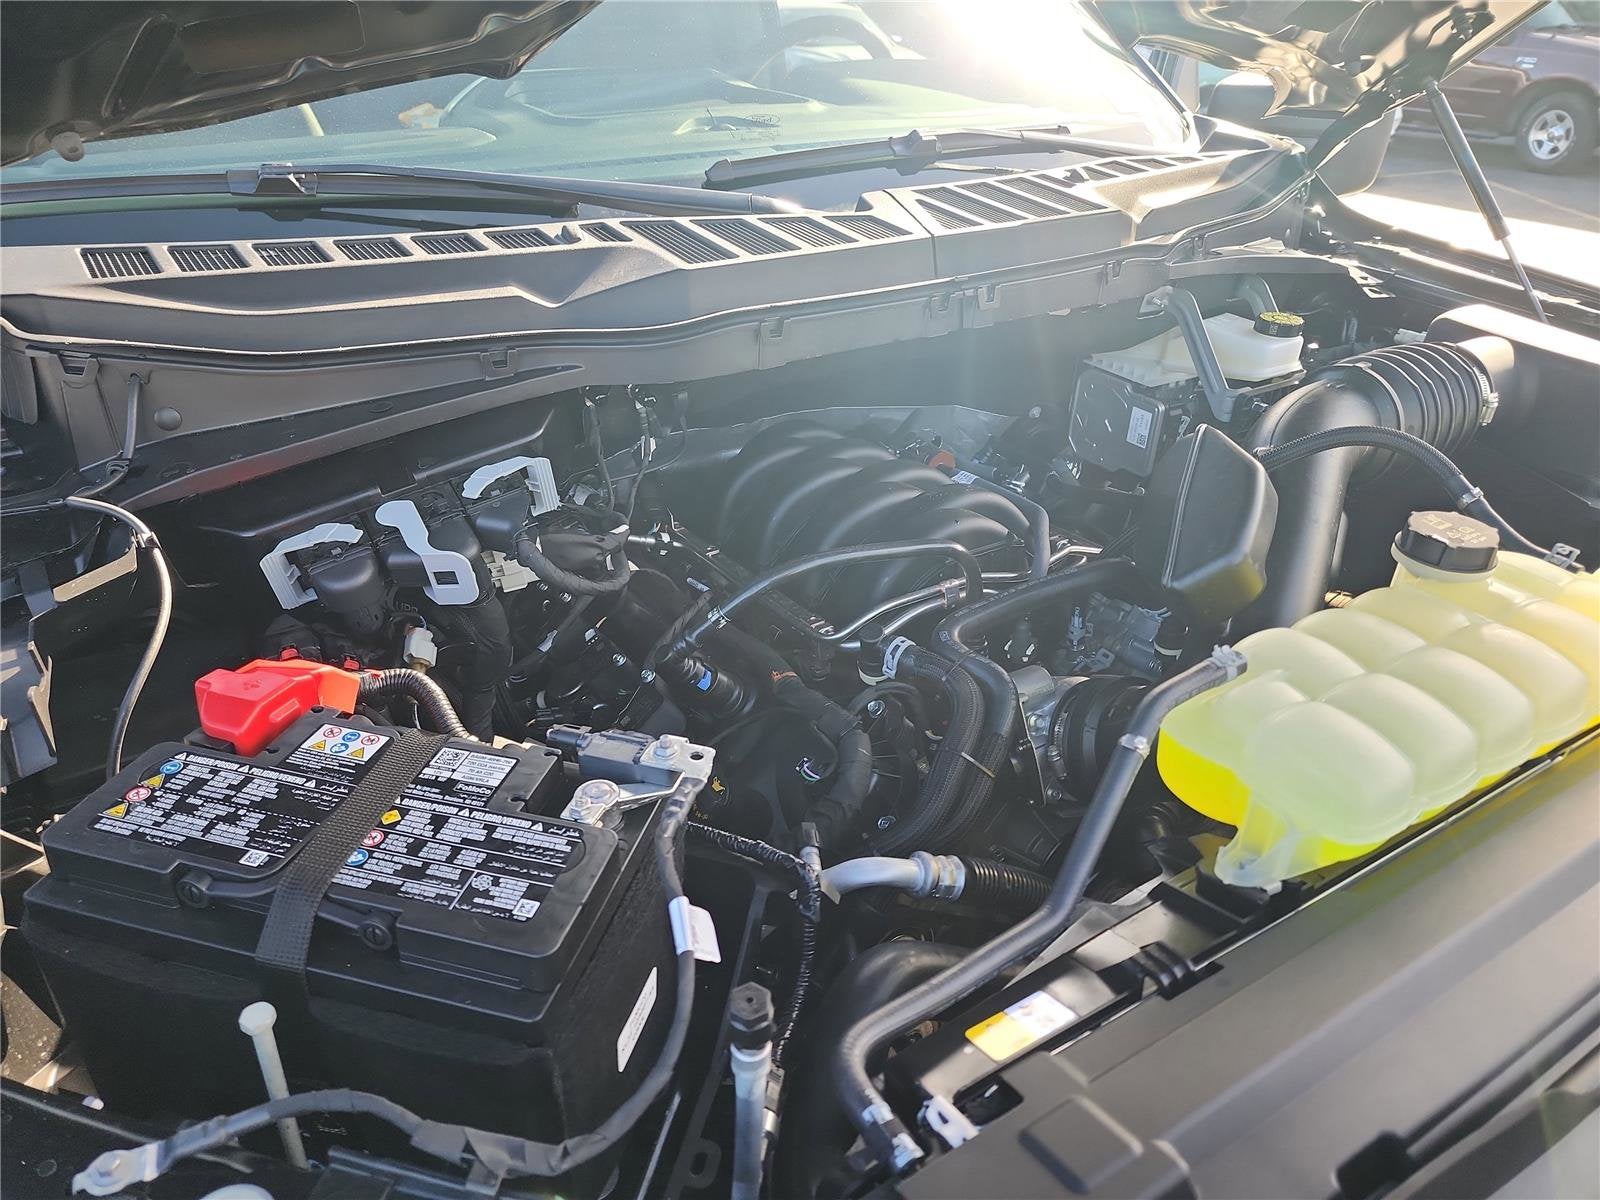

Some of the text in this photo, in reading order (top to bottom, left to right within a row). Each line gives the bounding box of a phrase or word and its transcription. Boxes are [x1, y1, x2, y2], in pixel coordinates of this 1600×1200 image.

[457, 783, 492, 795] FoMoCo
[401, 798, 460, 815] DANGER/POISON
[470, 810, 533, 829] PELIGRO/VENENO
